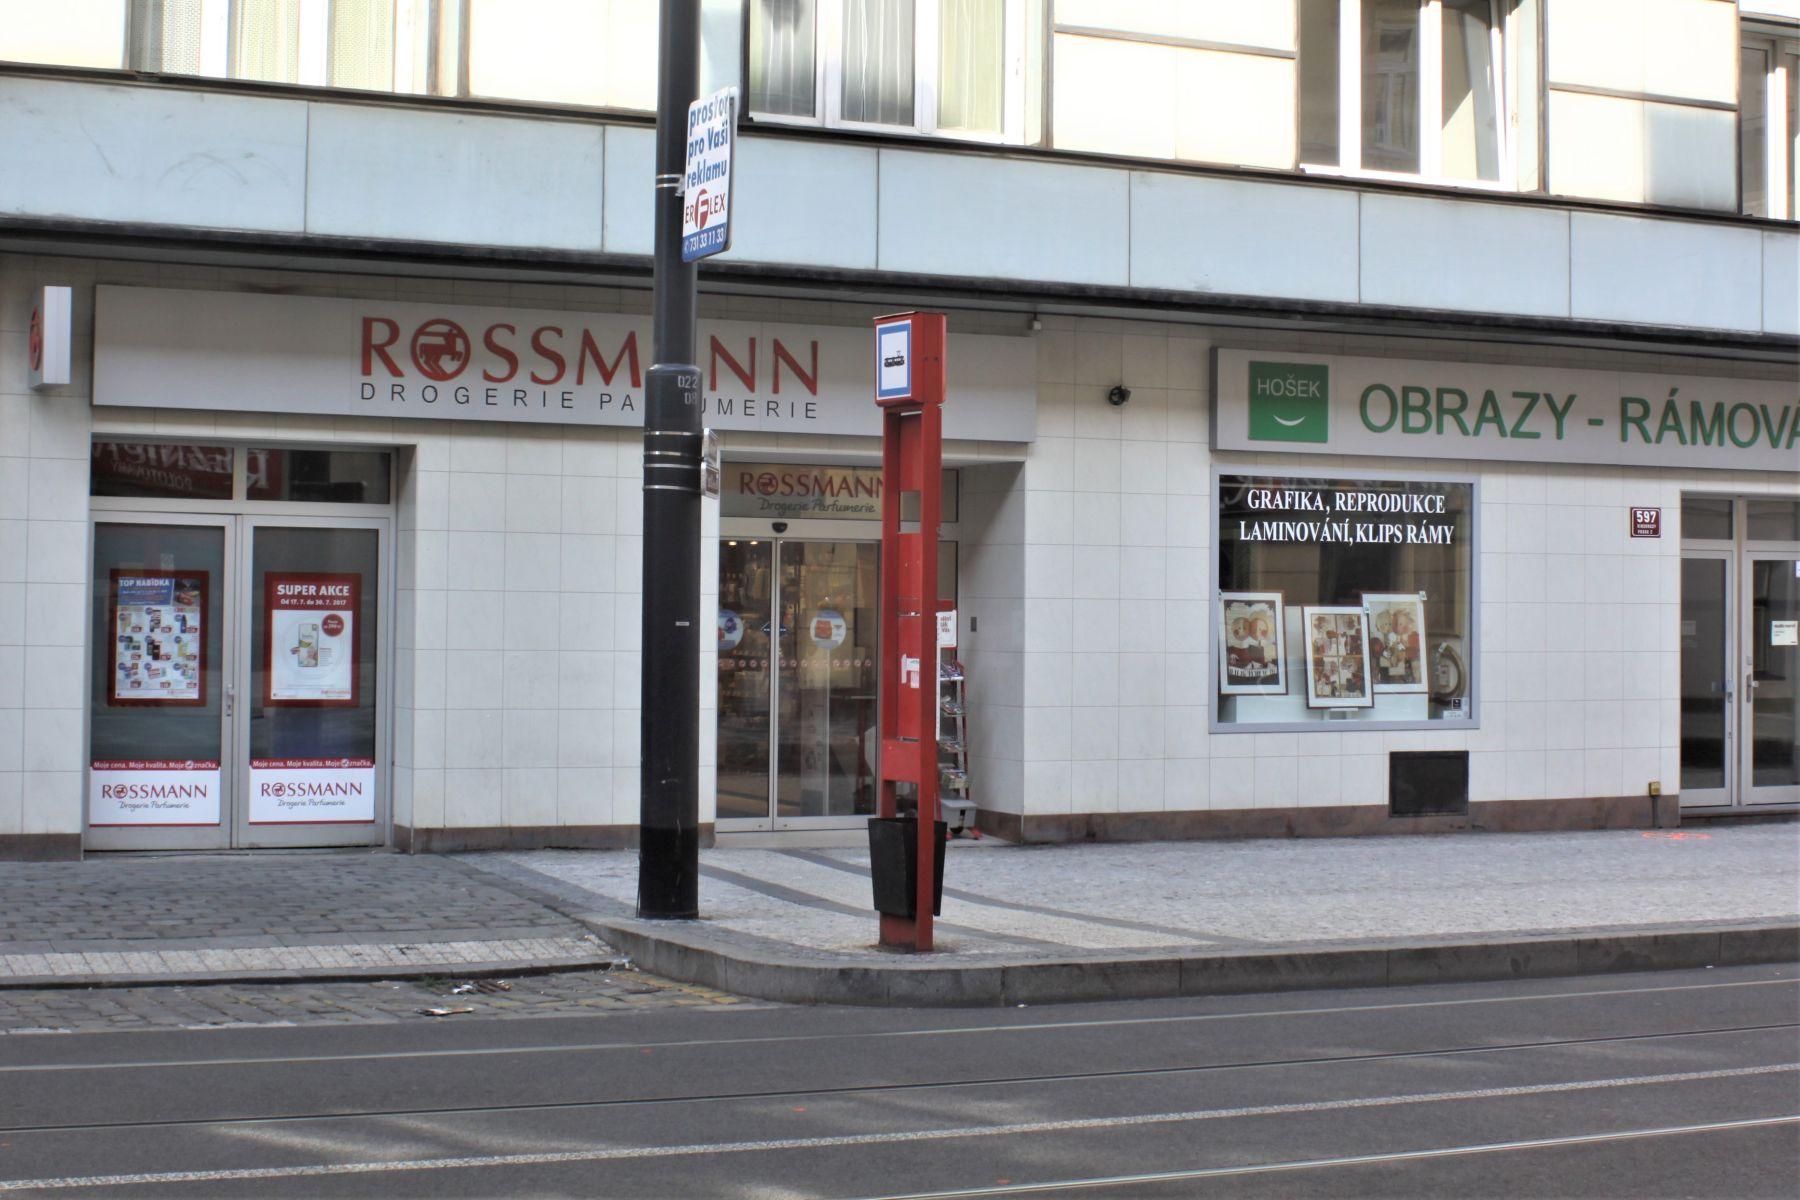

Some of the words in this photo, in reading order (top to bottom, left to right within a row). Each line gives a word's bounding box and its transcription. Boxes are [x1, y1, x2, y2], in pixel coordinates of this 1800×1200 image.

[688, 137, 704, 166] pro
[707, 119, 729, 150] Vaši
[686, 158, 728, 189] reklamu
[716, 227, 724, 244] 33
[361, 316, 819, 396] ROSSMNN
[1257, 373, 1321, 399] HOŠEK
[361, 382, 575, 410] DROGERIE
[1359, 383, 1577, 440] OBRAZY
[758, 497, 810, 517] Drogerie
[811, 498, 876, 515] Parfumerie
[1247, 489, 1330, 515] GRAFIKA,
[1335, 491, 1446, 515] REPRODUKCE
[1636, 510, 1657, 523] 597
[1406, 519, 1455, 545] RÁMY
[119, 579, 135, 587] TOP
[277, 584, 317, 596] SUPER
[319, 585, 350, 596] AKCE
[93, 761, 109, 769] Moje
[128, 761, 144, 769] Moje
[145, 761, 168, 769] kvalita.
[169, 761, 185, 769] Moje
[252, 760, 268, 768] Moje
[287, 760, 302, 768] Moje
[303, 760, 325, 768] kvalita.
[325, 760, 340, 768] Moje
[102, 784, 207, 799] ROSSMANN
[261, 782, 362, 797] ROSSMANN
[119, 801, 150, 812] Drogerie
[151, 801, 190, 809] Parfumerie
[278, 798, 307, 809] Drogerie
[308, 799, 345, 807] Parfumerie
